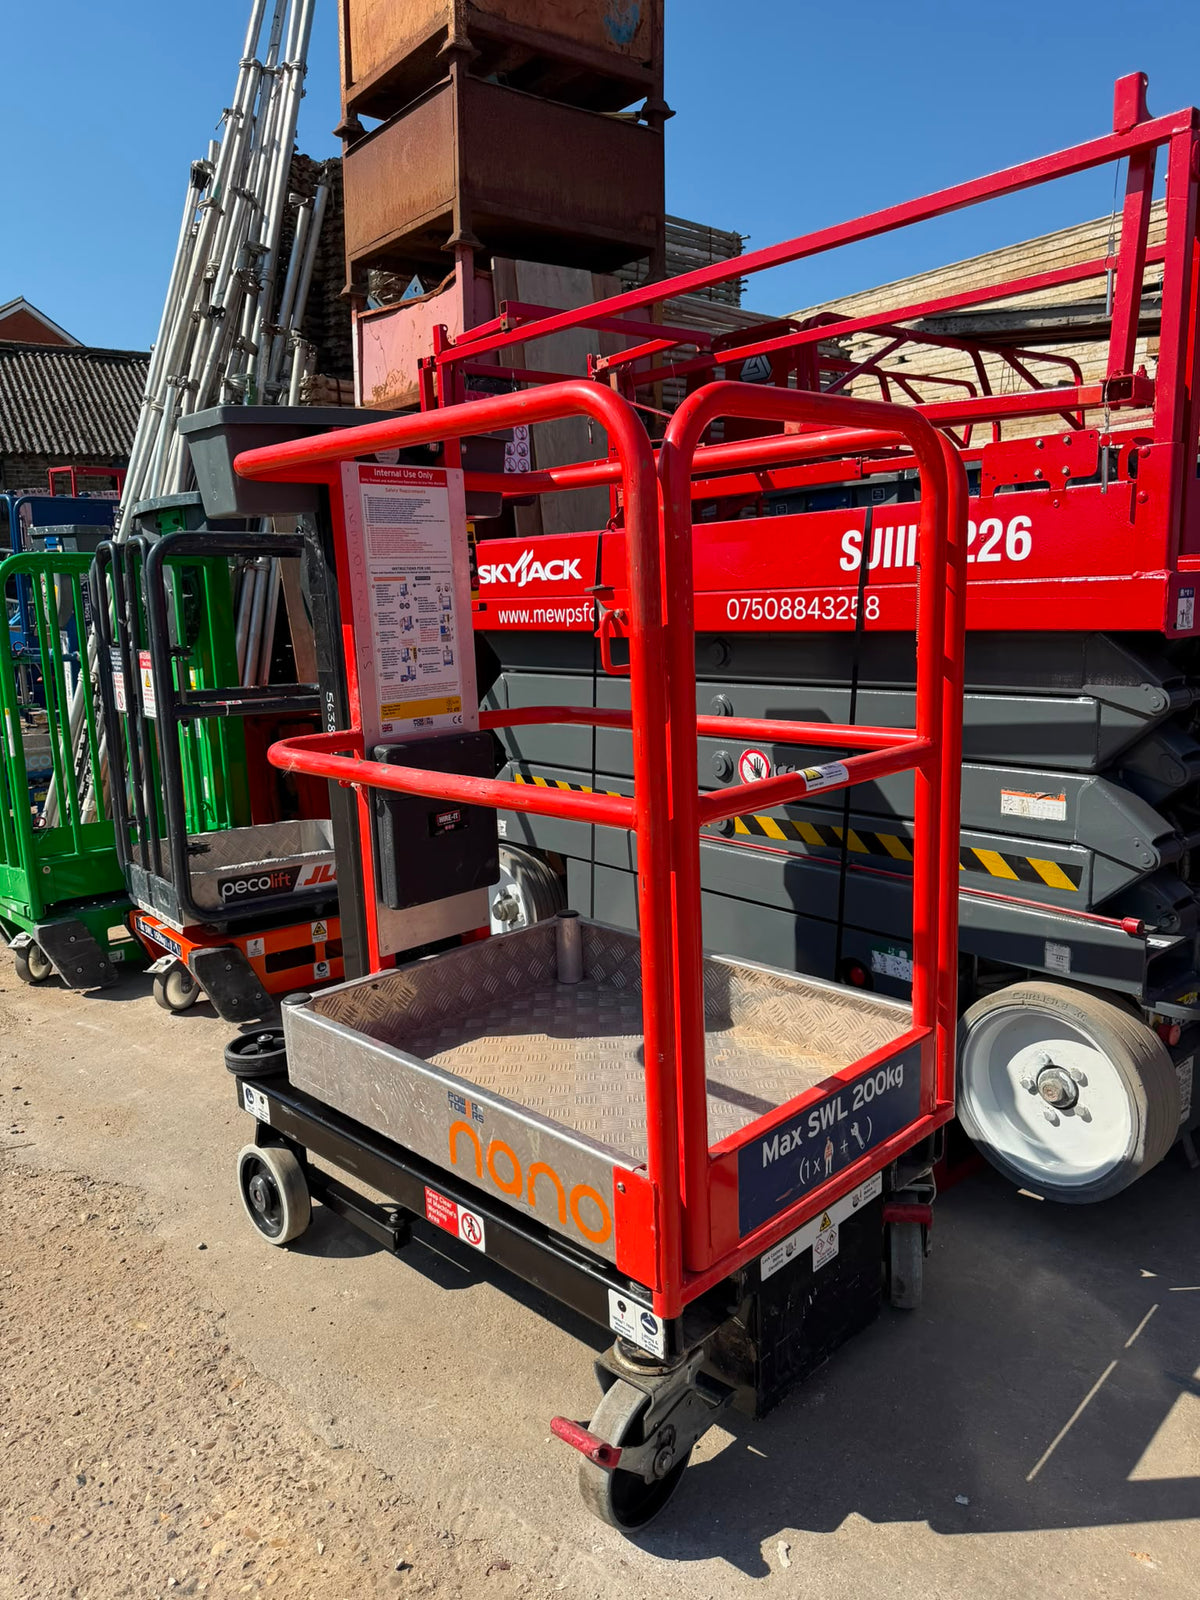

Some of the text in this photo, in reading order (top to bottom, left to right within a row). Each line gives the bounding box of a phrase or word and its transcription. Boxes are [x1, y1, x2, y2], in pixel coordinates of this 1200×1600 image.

[374, 468, 433, 480] Internal Use Only
[478, 549, 582, 587] SKYJACK
[326, 691, 336, 732] 5638
[304, 864, 337, 885] JL
[222, 872, 291, 903] pecolift
[762, 1064, 904, 1168] Max SWL 200kg
[449, 1121, 612, 1244] nano
[426, 1190, 452, 1208] Keep Clear
[432, 1199, 456, 1219] Machine's
[428, 1204, 447, 1222] Working
[428, 1212, 440, 1224] Area
